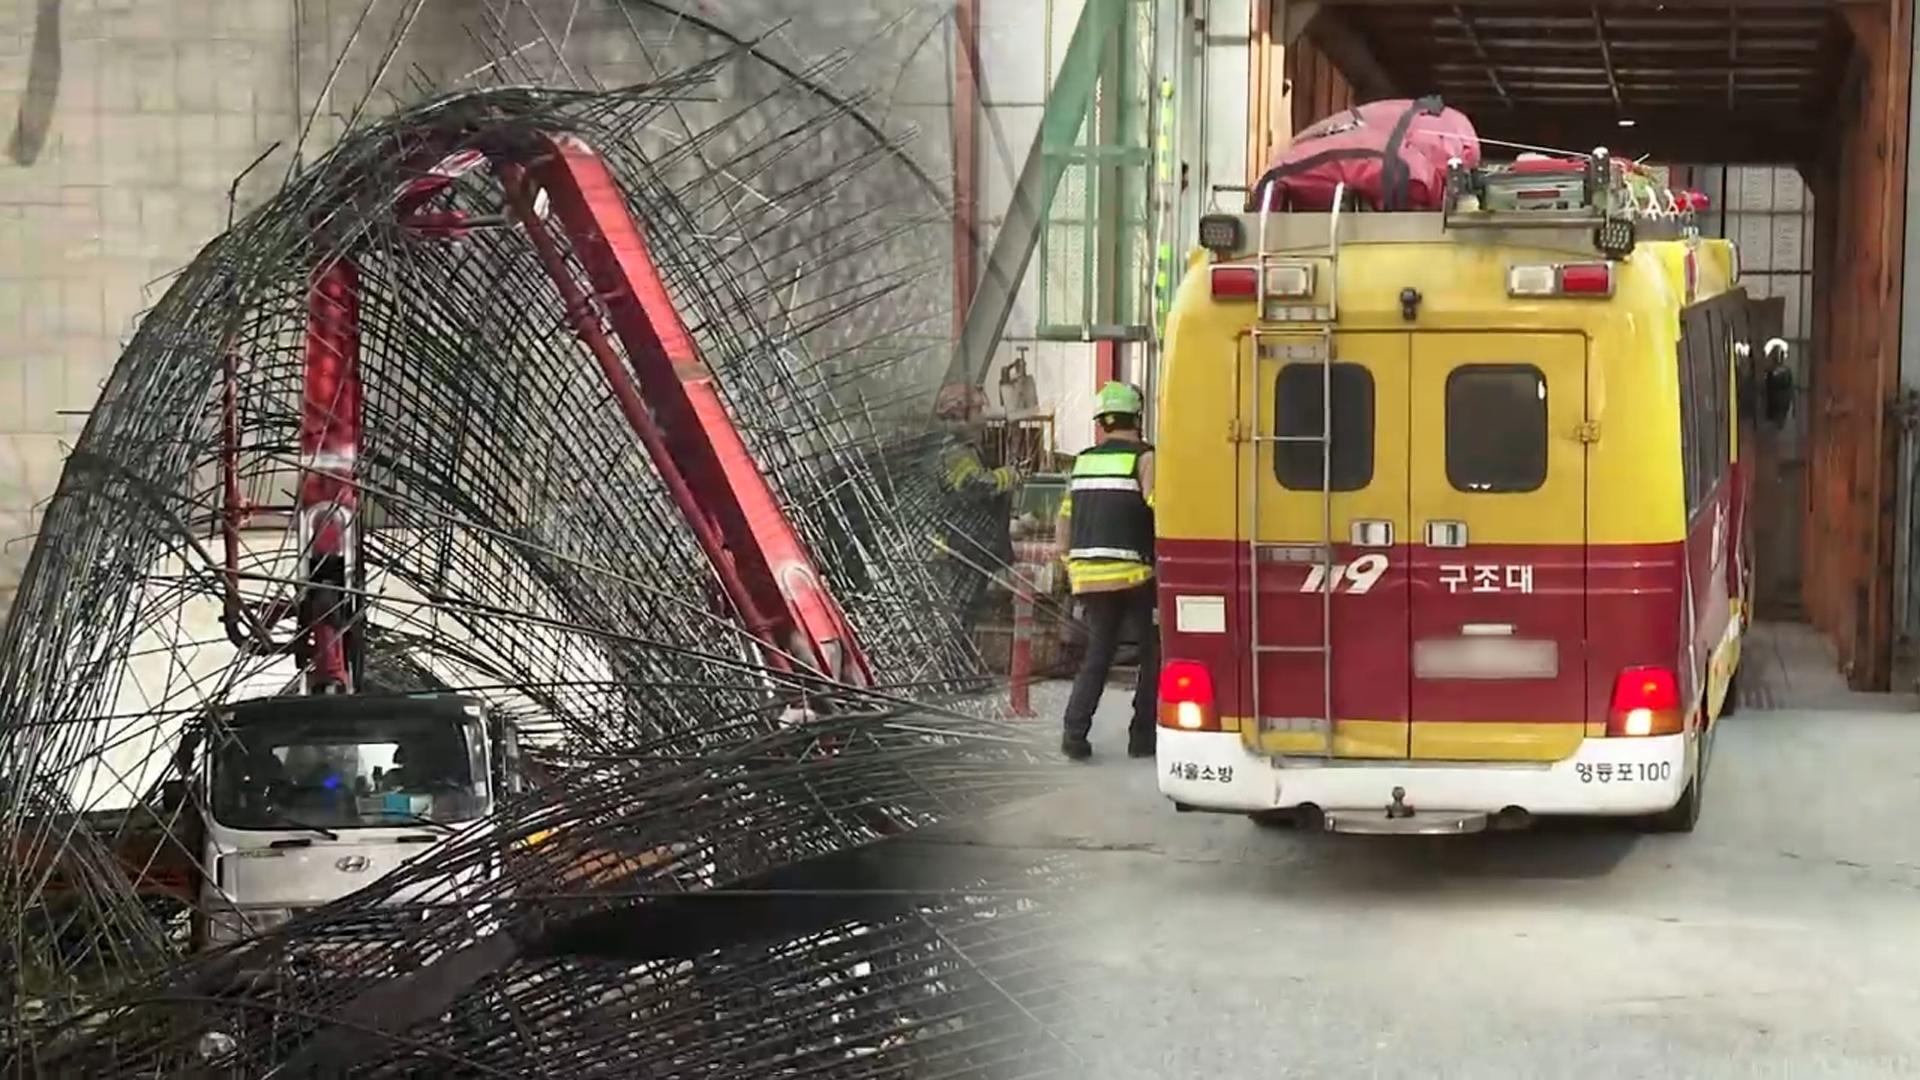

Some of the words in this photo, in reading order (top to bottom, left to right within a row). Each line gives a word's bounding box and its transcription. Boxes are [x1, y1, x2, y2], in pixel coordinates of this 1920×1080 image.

[1300, 554, 1389, 594] 119
[1439, 565, 1534, 594] 구조대
[1169, 761, 1233, 783] 서울소방
